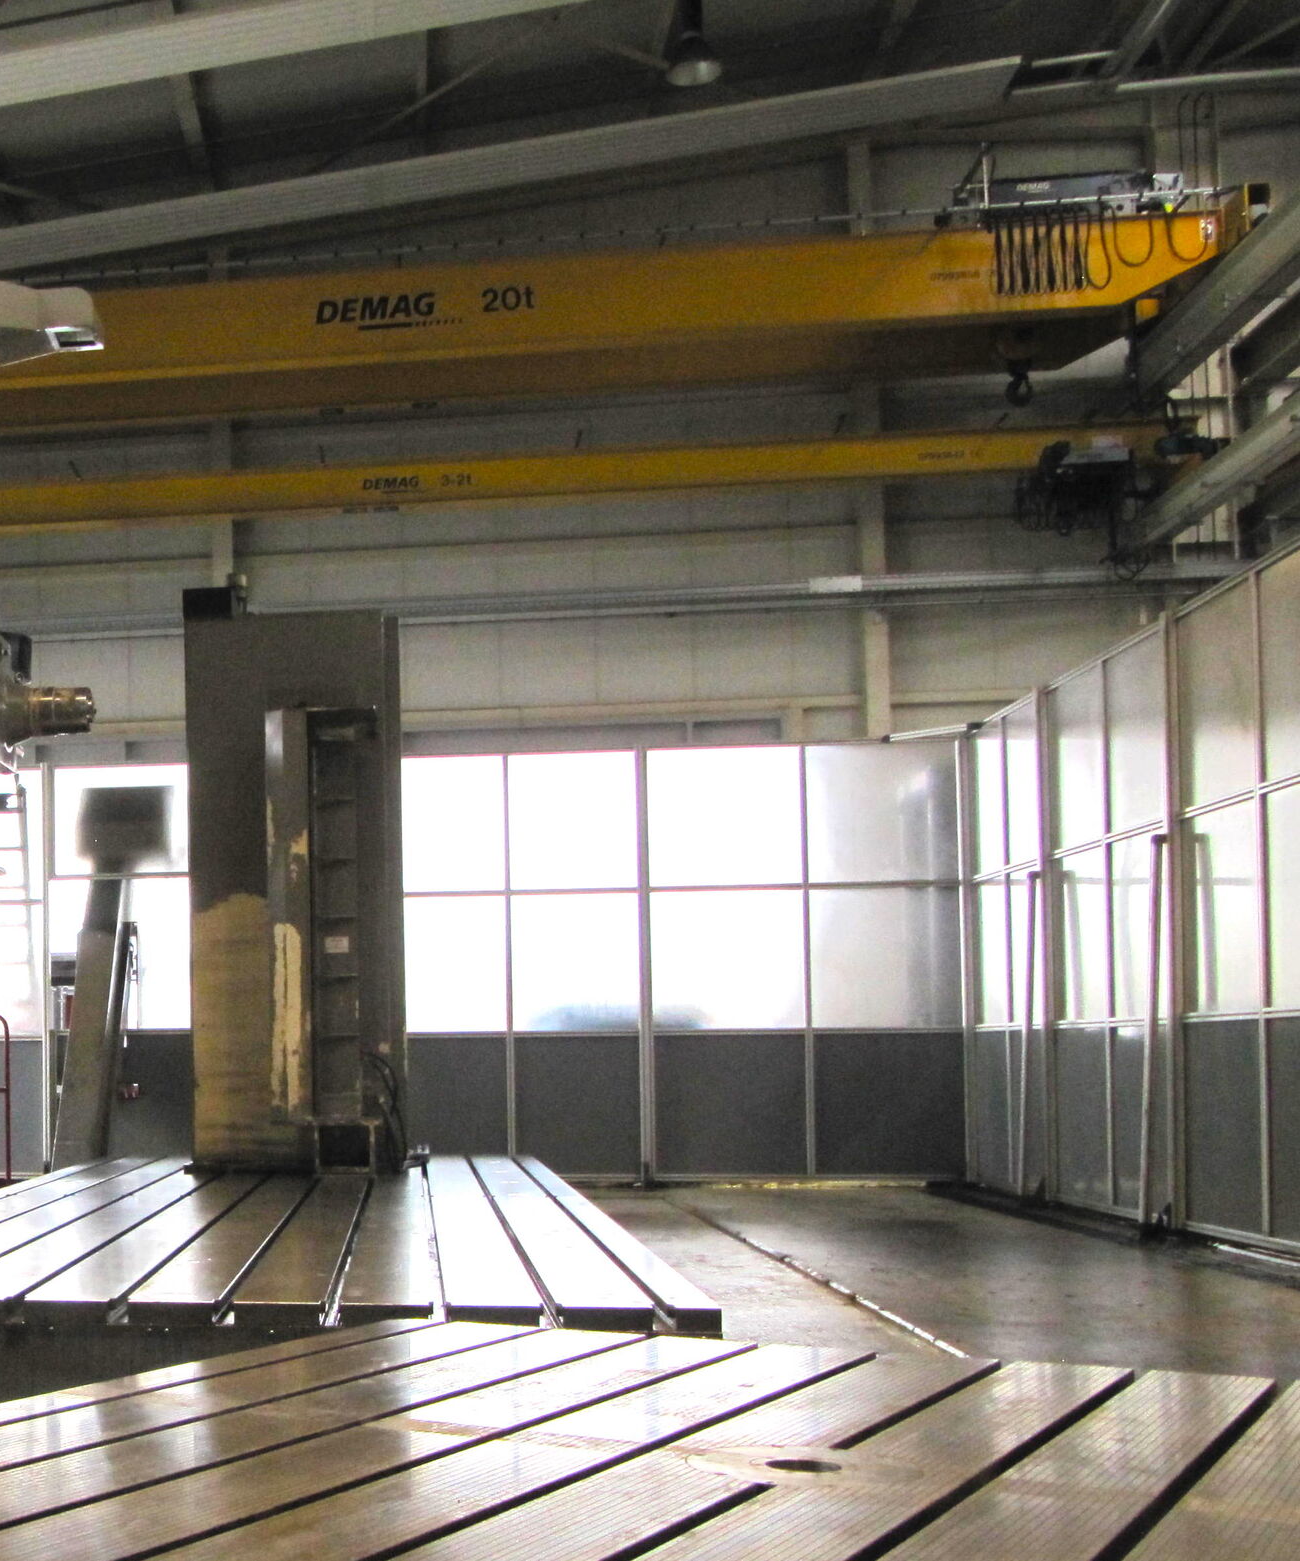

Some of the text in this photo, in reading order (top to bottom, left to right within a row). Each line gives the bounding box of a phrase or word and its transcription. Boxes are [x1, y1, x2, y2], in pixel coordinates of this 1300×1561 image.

[316, 286, 535, 325] DEMAG 20t
[363, 475, 420, 490] DEMAG
